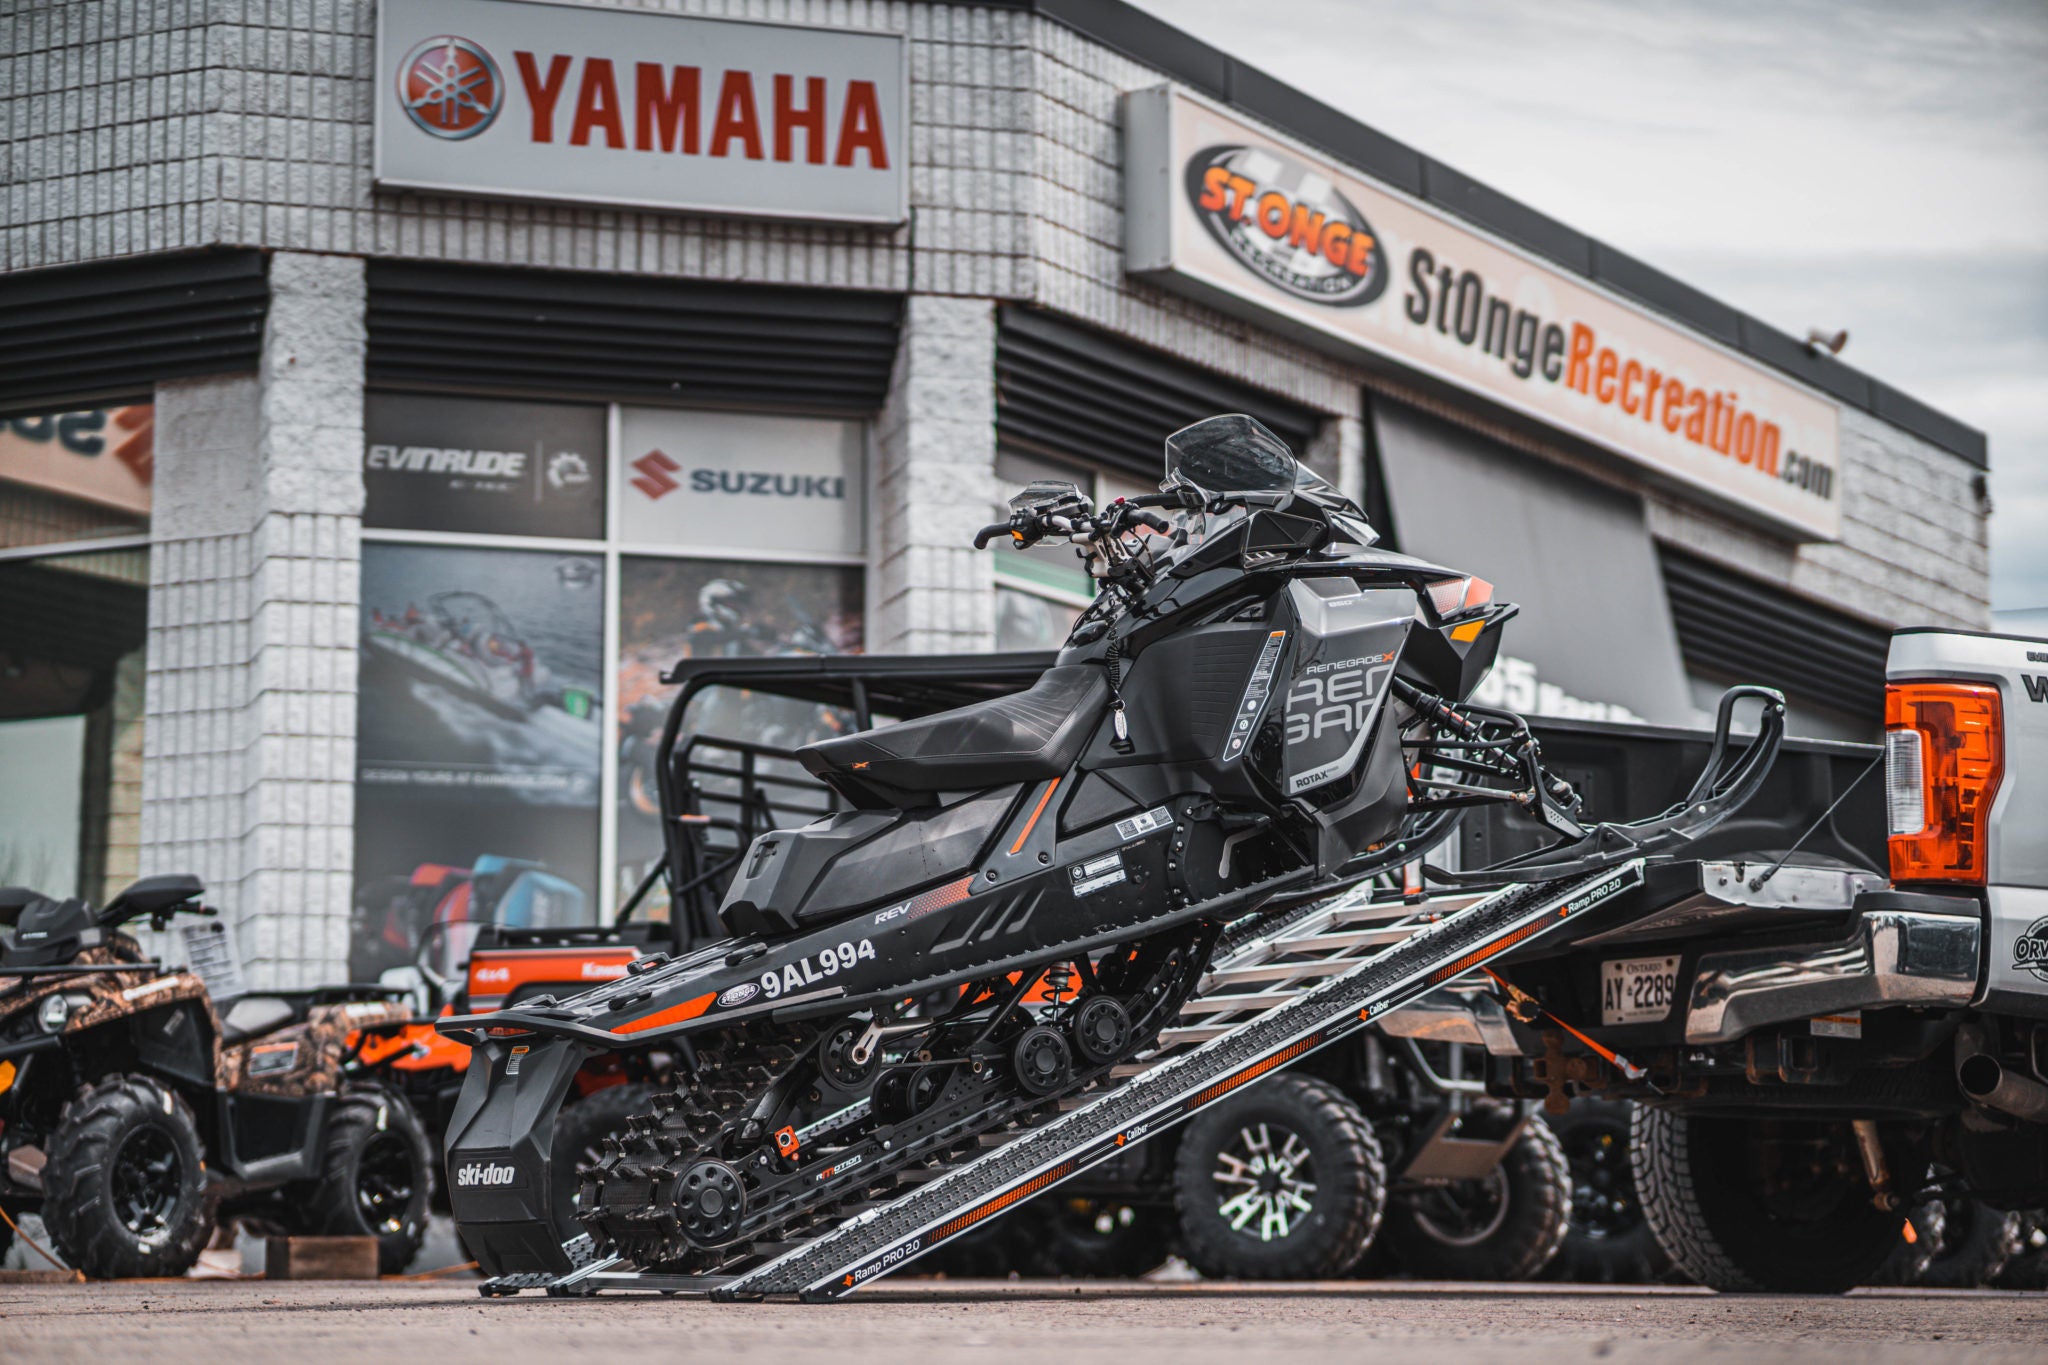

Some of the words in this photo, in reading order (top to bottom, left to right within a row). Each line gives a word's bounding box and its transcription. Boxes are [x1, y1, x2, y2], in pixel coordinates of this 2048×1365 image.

[513, 50, 891, 171] YAMAHA
[366, 444, 528, 478] EVINRUDE
[689, 467, 847, 500] SUZUKI
[1295, 770, 1329, 789] ROTAX
[1567, 896, 1590, 914] Ramp
[1590, 886, 1609, 902] PRO
[1609, 878, 1622, 892] 2.0
[874, 902, 912, 925] REV
[760, 938, 877, 999] 9AL994
[1626, 962, 1663, 975] ONTARIO
[1369, 999, 1390, 1016] Caliber
[1604, 977, 1624, 1011] AY
[1126, 1123, 1149, 1141] Caliber
[457, 1162, 516, 1187] ski-doo
[854, 1261, 882, 1282] Ramp
[882, 1247, 905, 1267] PRO
[905, 1239, 920, 1255] 2.0
